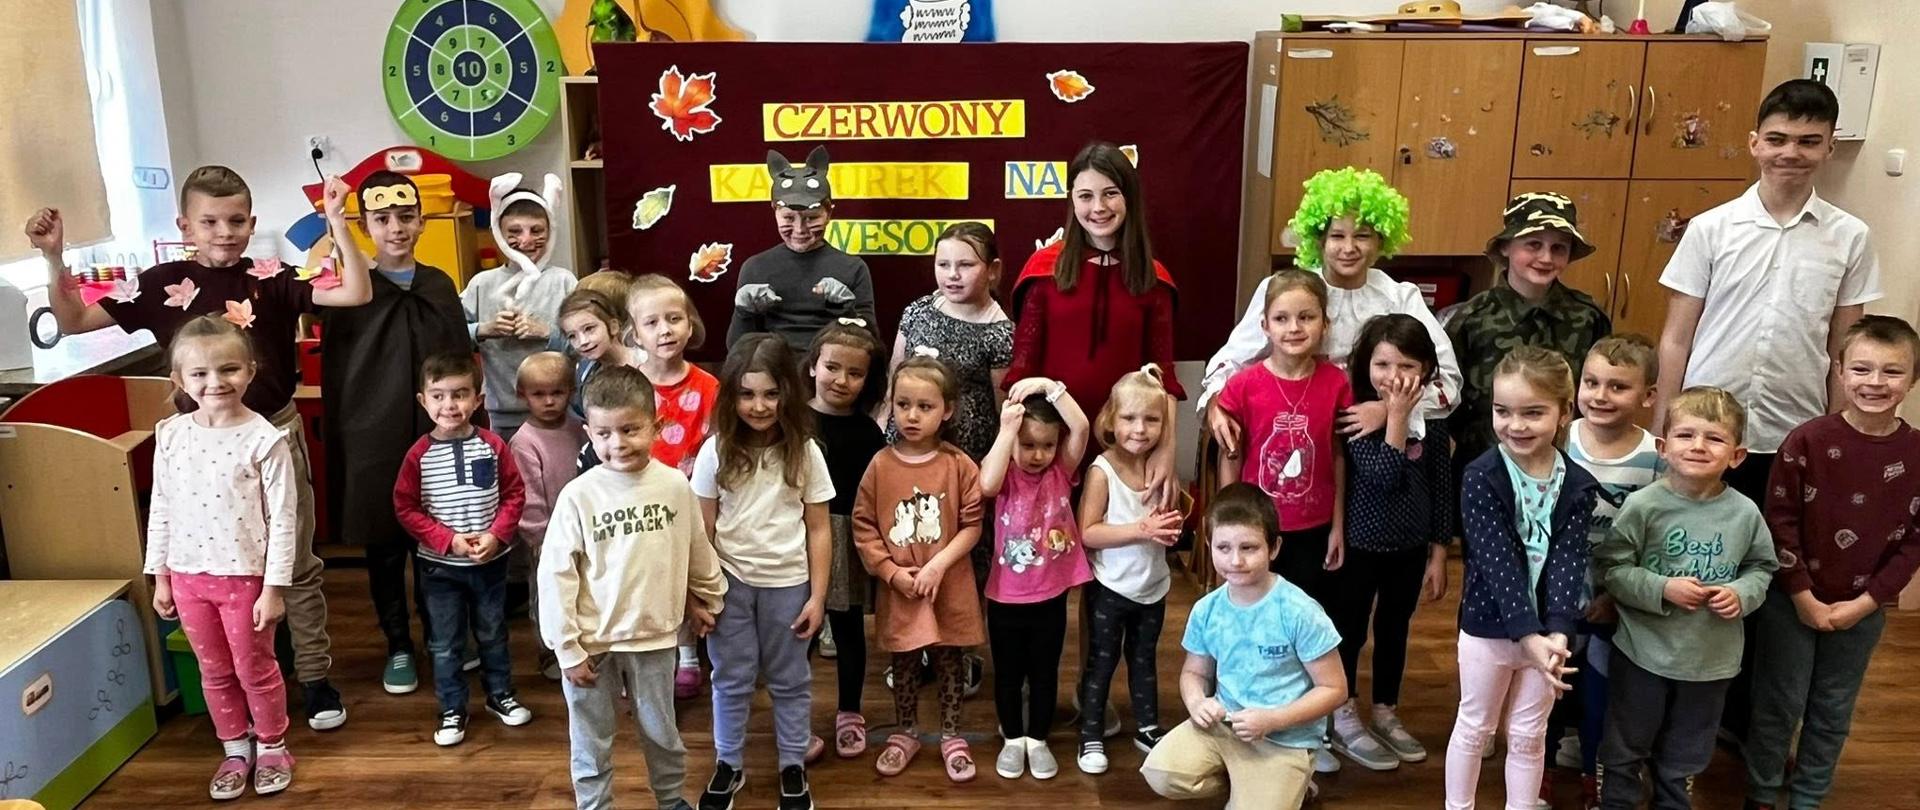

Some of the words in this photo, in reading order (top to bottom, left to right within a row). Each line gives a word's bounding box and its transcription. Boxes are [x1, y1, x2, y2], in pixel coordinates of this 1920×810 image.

[435, 15, 444, 27] 4
[489, 13, 497, 25] 6
[449, 38, 457, 49] 9
[478, 37, 486, 49] 7
[389, 66, 397, 77] 2
[413, 65, 421, 77] 5
[437, 64, 445, 76] 8
[458, 61, 481, 78] 10
[494, 63, 503, 75] 8
[520, 62, 528, 74] 5
[546, 61, 555, 73] 2
[452, 90, 460, 101] 7
[440, 111, 449, 122] 6
[493, 111, 501, 123] 4
[772, 101, 1013, 138] CZERWONY
[430, 135, 436, 146] 1
[507, 135, 515, 146] 3
[714, 165, 950, 199] KAUREK
[1006, 162, 1066, 195] NA
[592, 506, 639, 528] LOOK
[643, 503, 661, 519] AT
[593, 524, 617, 543] MY
[623, 517, 664, 535] BACK
[1665, 526, 1723, 557] Best
